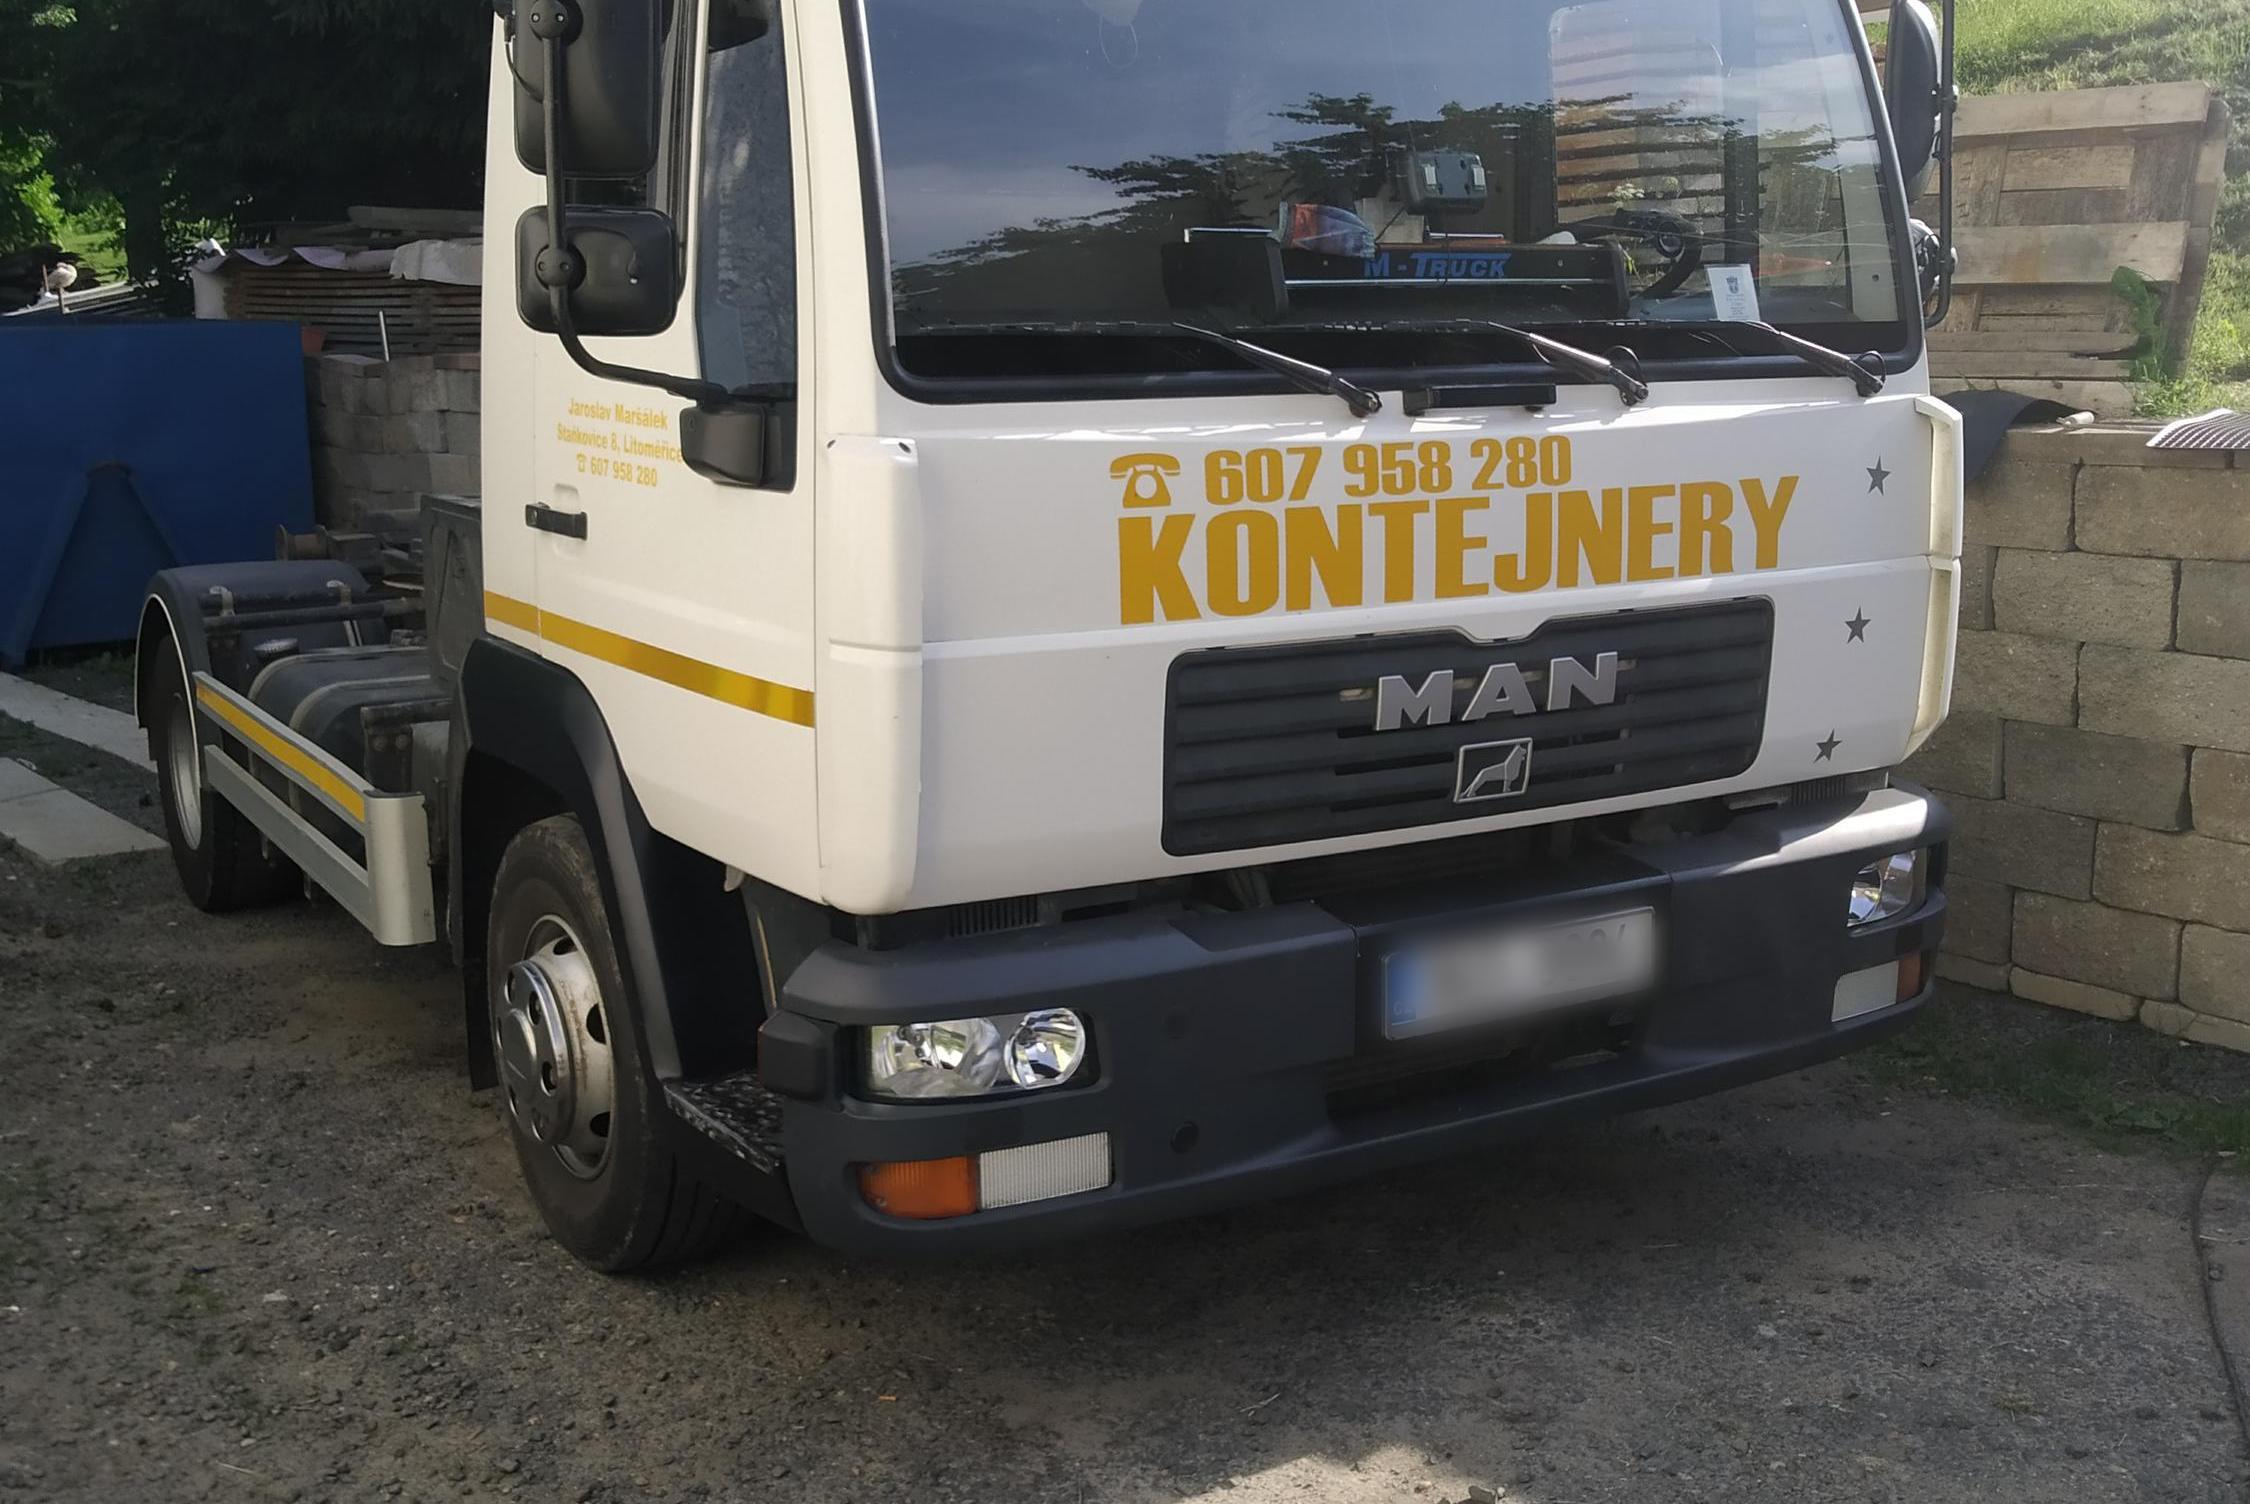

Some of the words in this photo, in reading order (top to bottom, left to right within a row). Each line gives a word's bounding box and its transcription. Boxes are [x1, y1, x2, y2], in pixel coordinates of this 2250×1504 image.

[1364, 252, 1389, 277] M
[568, 399, 611, 420] Jaroslav
[615, 403, 668, 428] Maršálek
[557, 422, 608, 449] Staňkovice
[591, 455, 609, 477] 607
[613, 461, 633, 482] 958
[636, 464, 658, 487] 280
[1204, 447, 1322, 505] 607
[1343, 441, 1453, 497] 958
[1470, 435, 1572, 491] 280
[1118, 476, 1800, 625] KONTEJNERY
[1375, 651, 1618, 731] MAN
